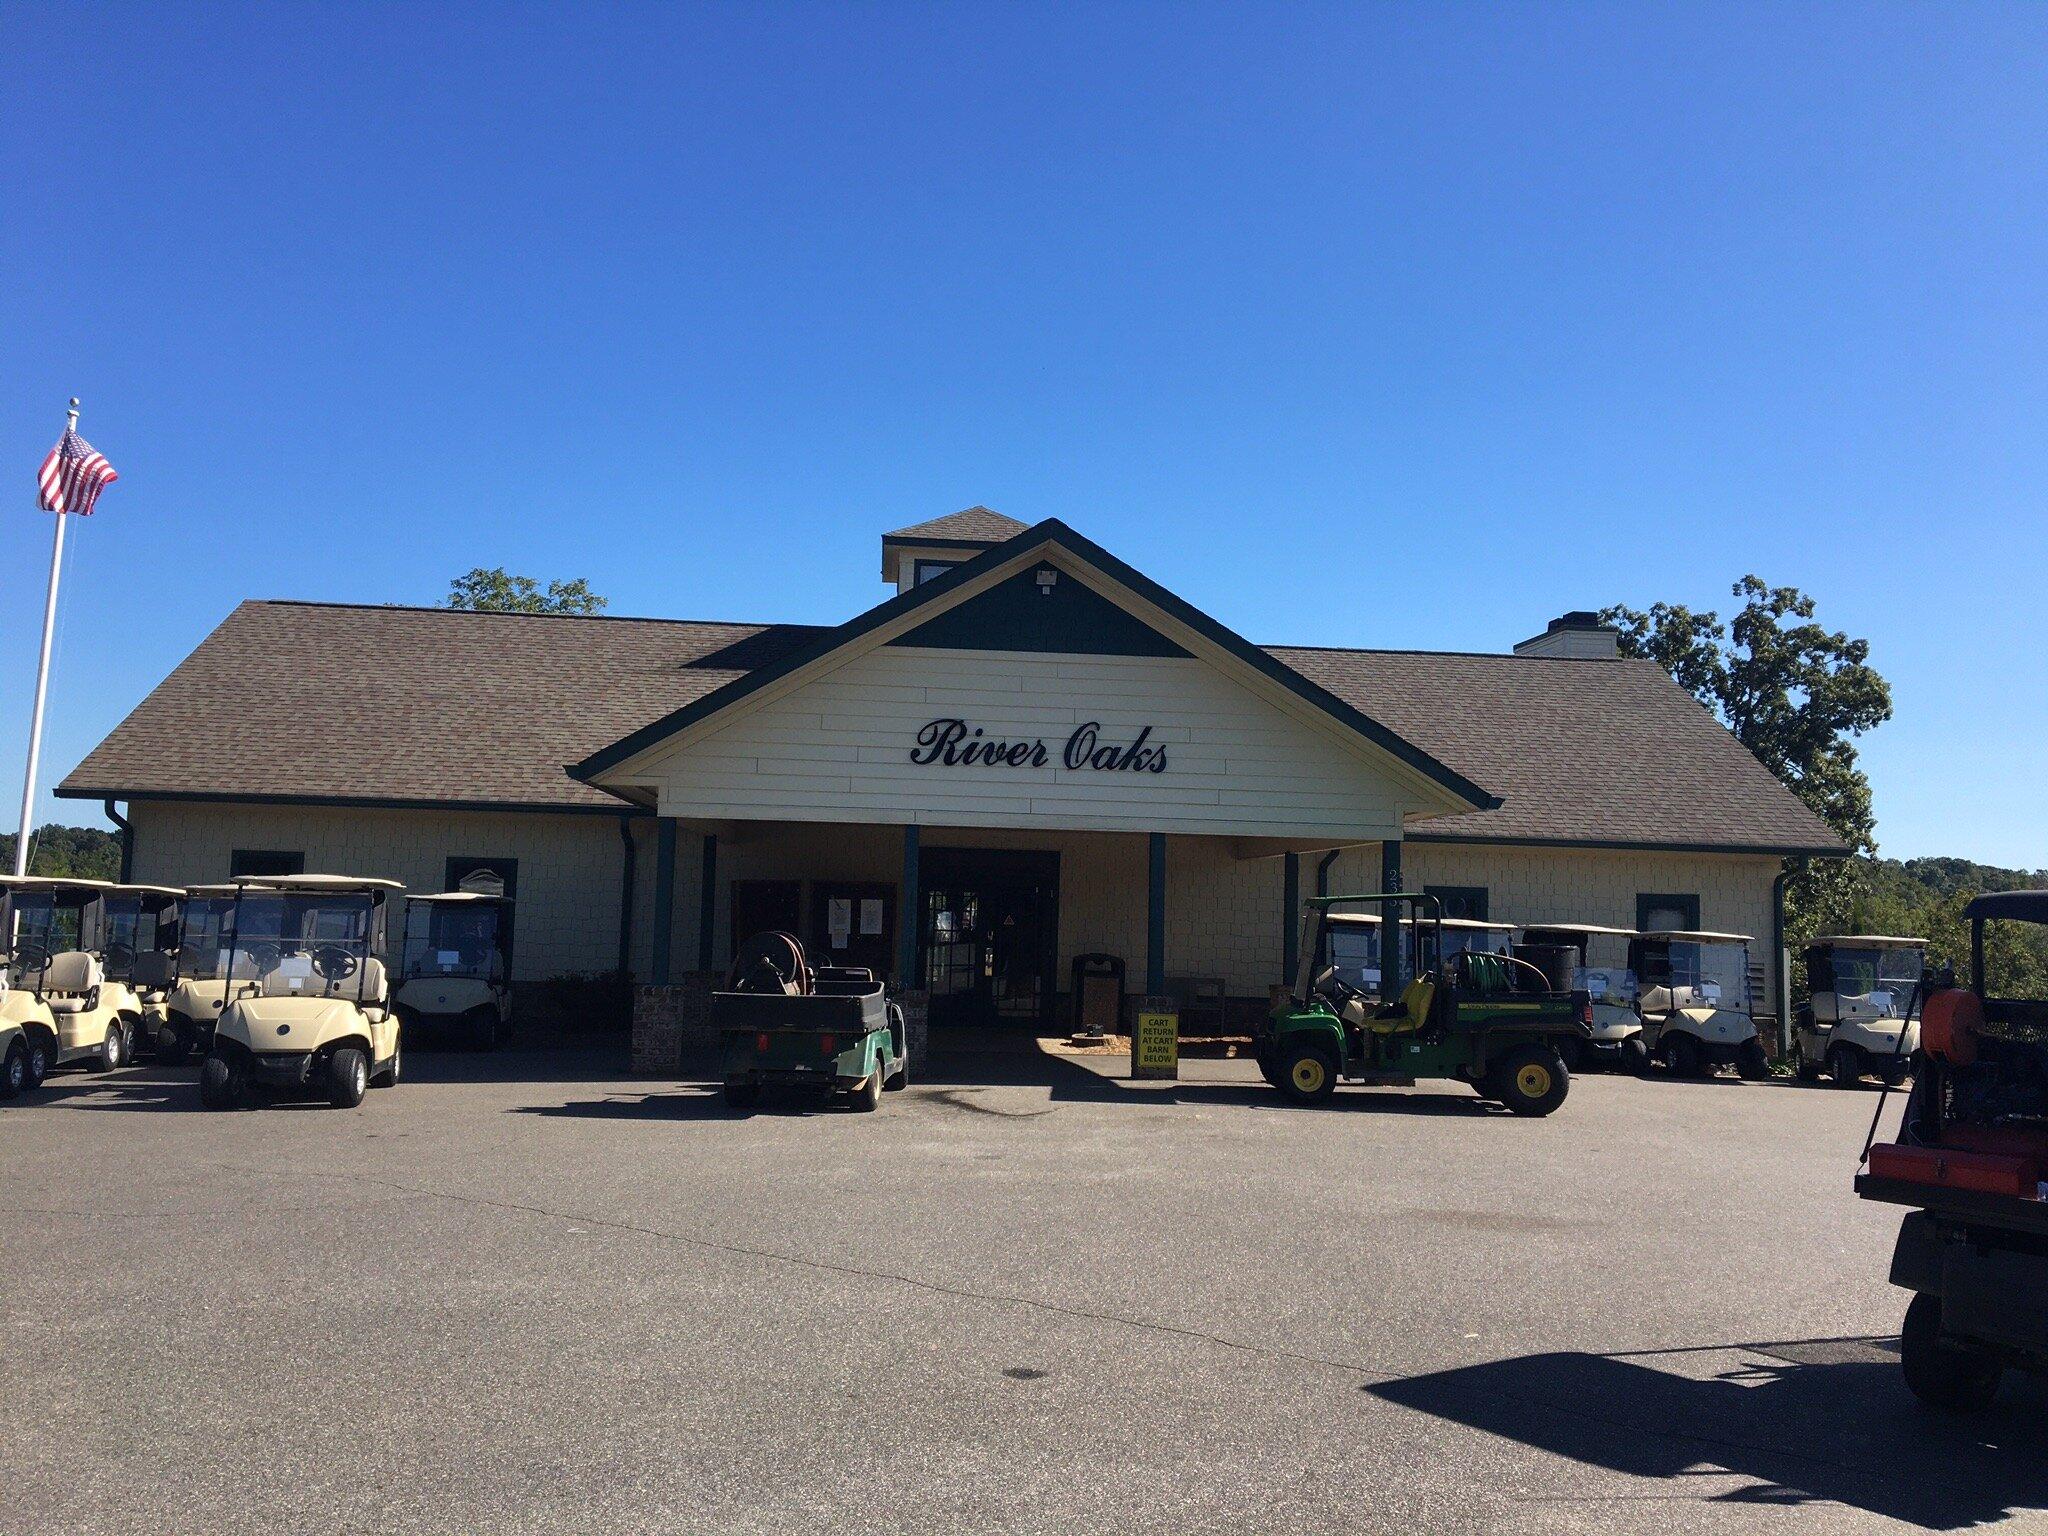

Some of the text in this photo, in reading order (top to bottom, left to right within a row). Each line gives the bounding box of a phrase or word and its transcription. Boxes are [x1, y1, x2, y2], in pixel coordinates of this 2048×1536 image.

[910, 718, 1167, 773] River Oaks
[1148, 1018, 1169, 1027] CART
[1143, 1027, 1174, 1036] RETURN
[1142, 1036, 1174, 1045] AT CART
[1147, 1045, 1169, 1054] BARN
[1143, 1054, 1172, 1063] BELOW
